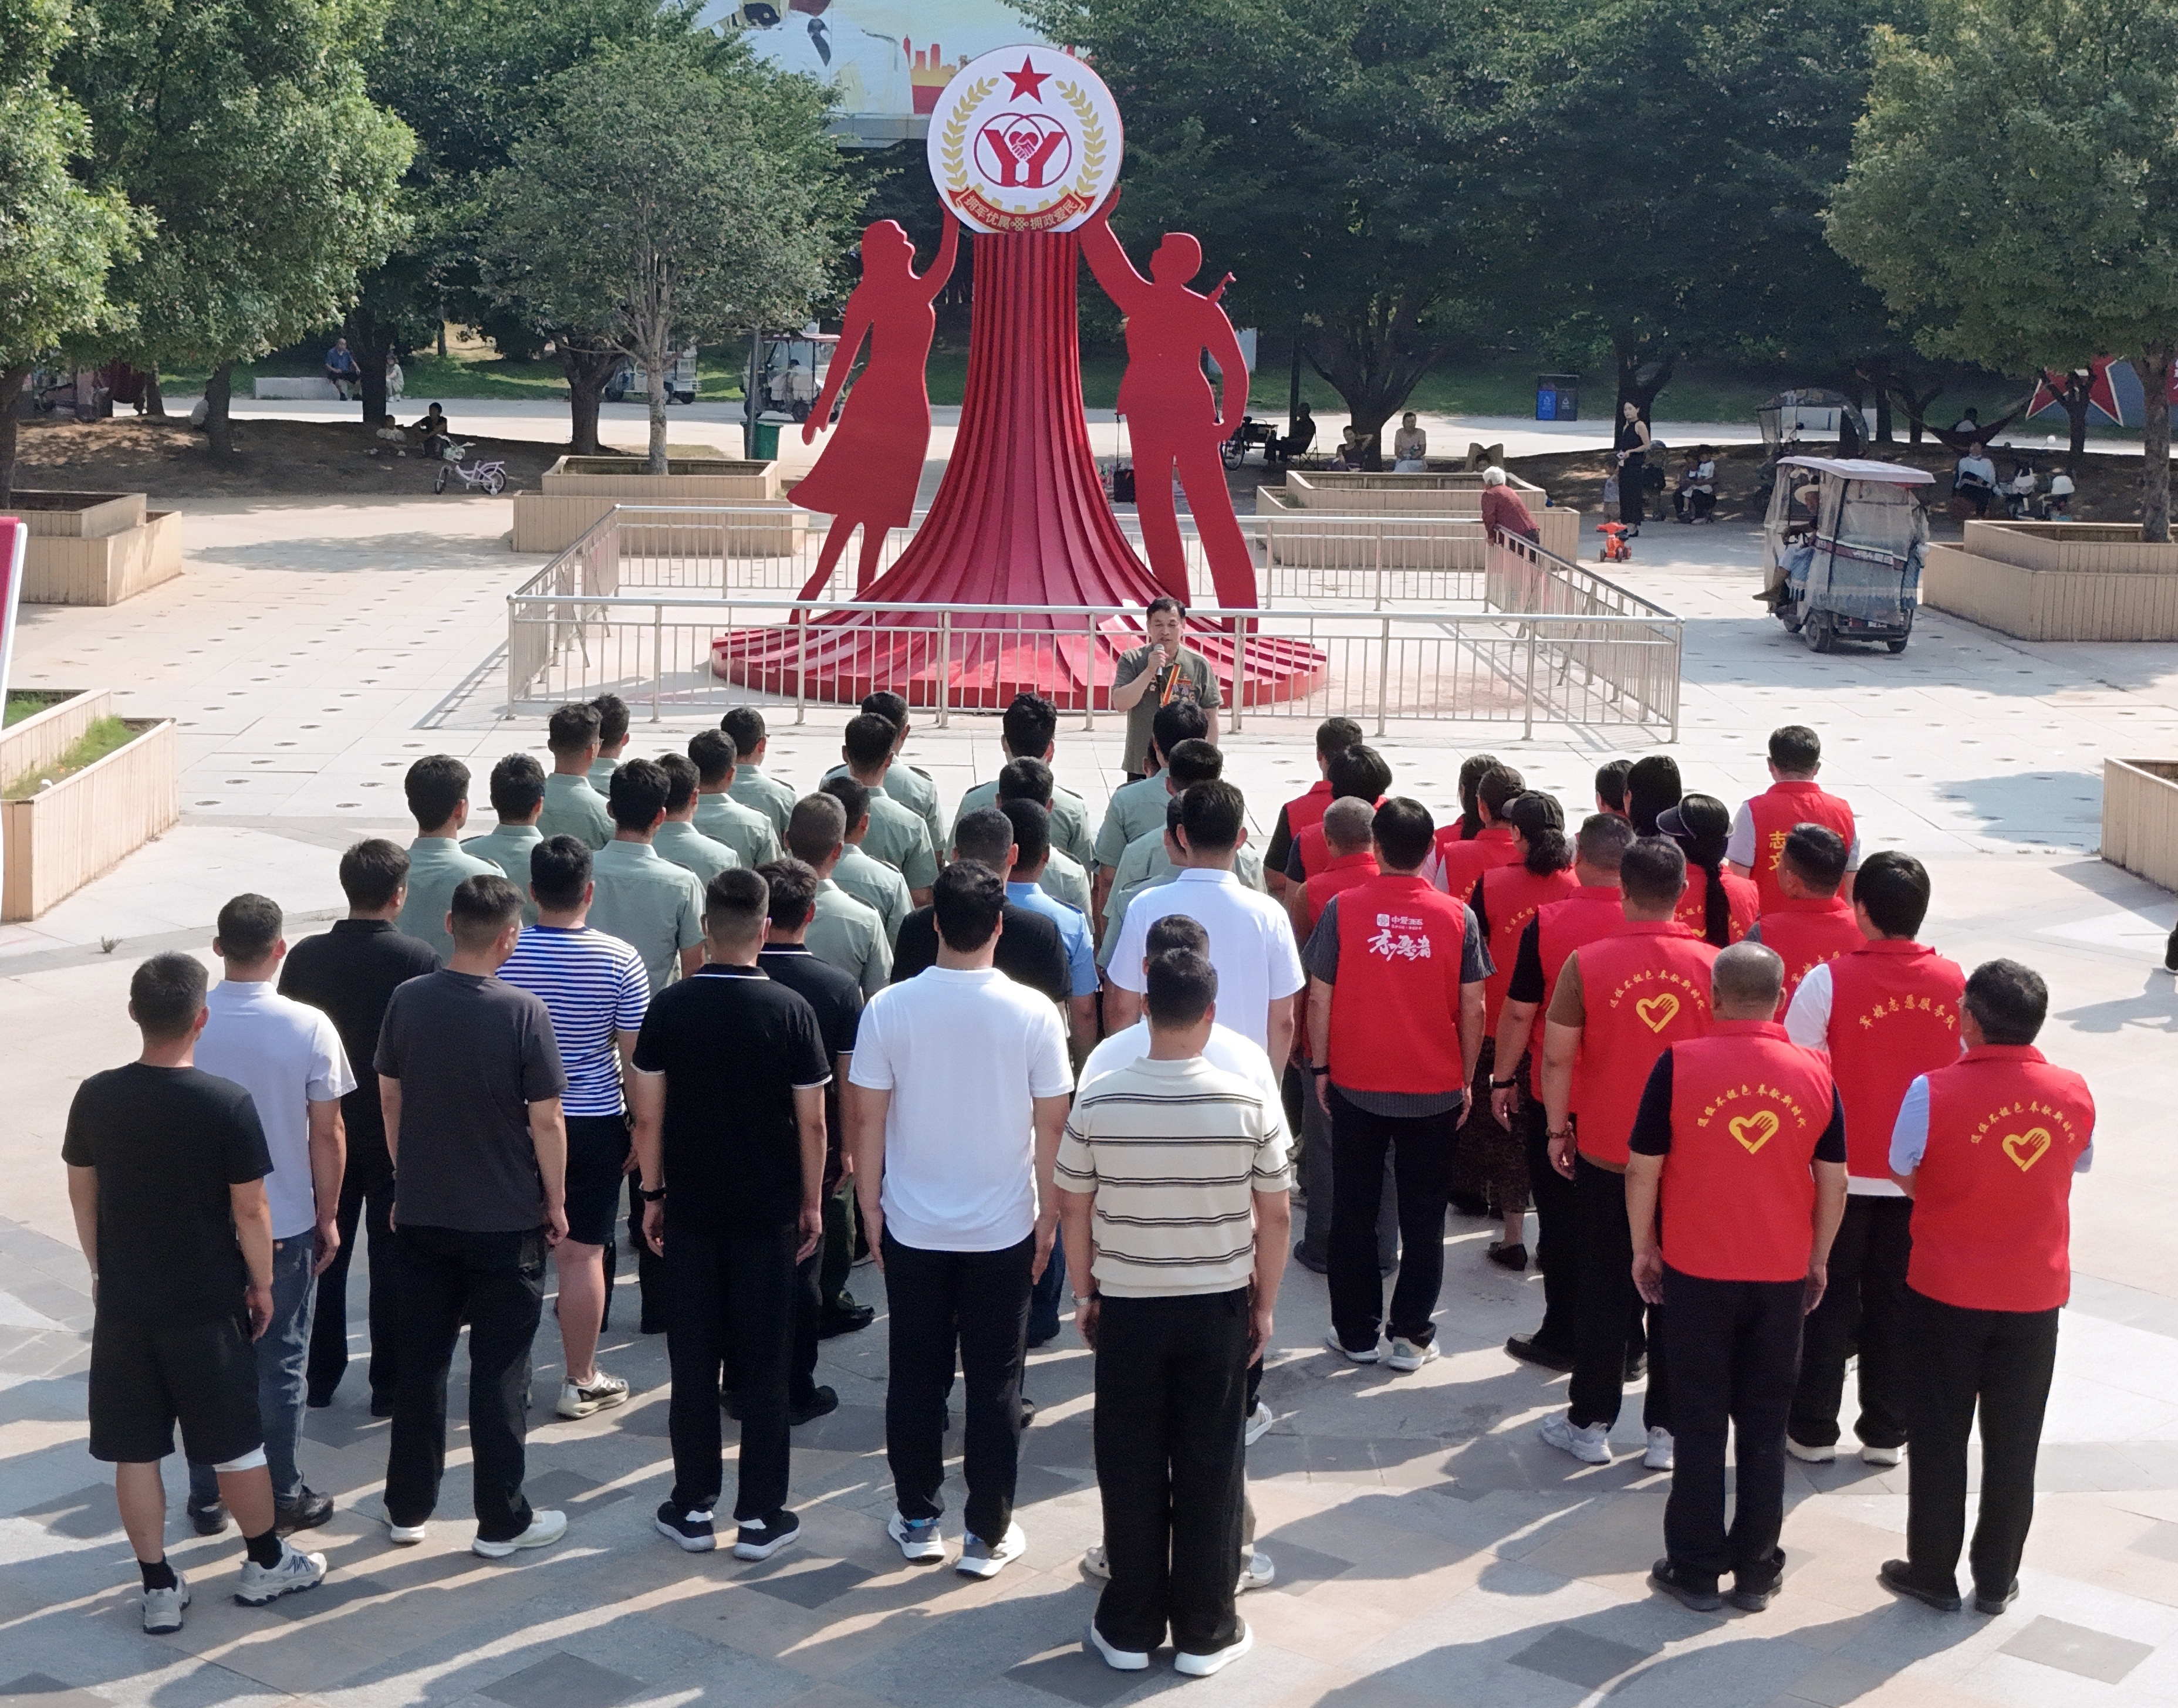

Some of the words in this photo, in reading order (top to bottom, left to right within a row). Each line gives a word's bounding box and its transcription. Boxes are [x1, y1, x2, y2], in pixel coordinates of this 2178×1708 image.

[964, 195, 1011, 230] 拥军优属
[1030, 198, 1078, 230] 拥政爱民
[1367, 929, 1431, 962] 志愿者
